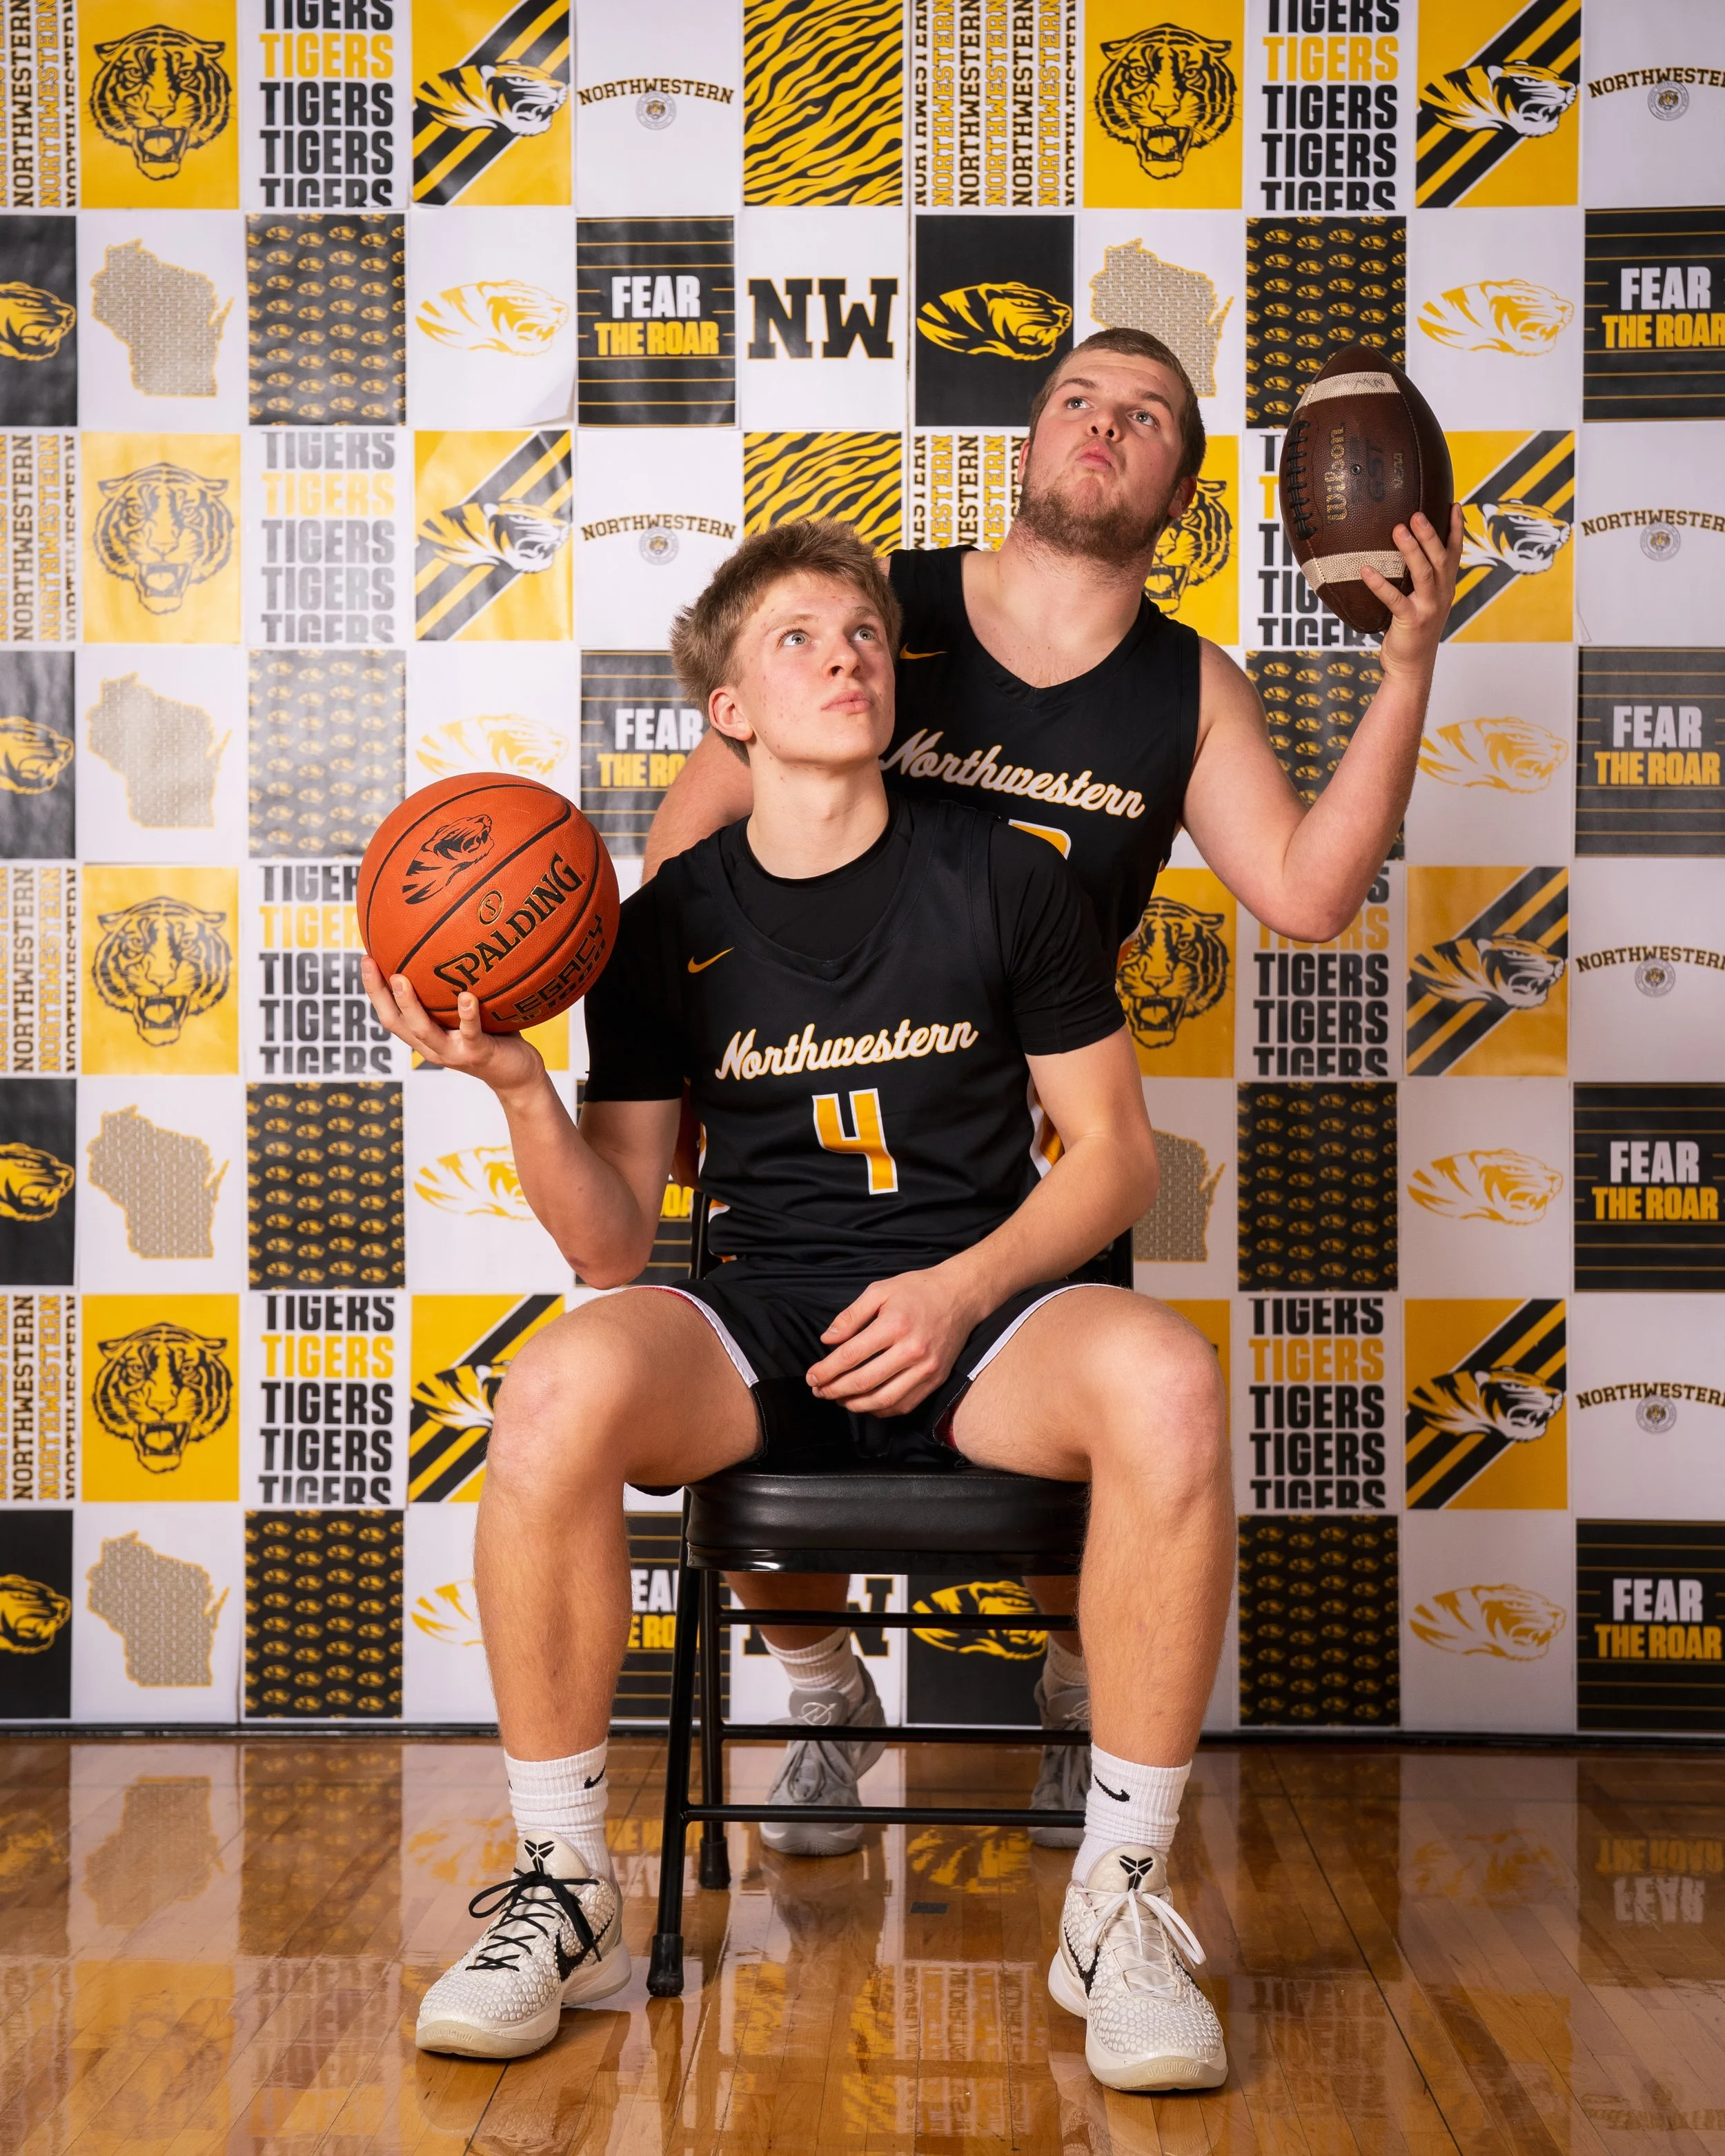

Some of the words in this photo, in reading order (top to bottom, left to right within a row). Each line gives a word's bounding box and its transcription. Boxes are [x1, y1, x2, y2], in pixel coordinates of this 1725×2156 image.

[265, 0, 393, 30] TIGERS
[1268, 0, 1399, 32] TIGERS
[259, 32, 393, 79] TIGERS
[1263, 36, 1399, 81] TIGERS
[10, 0, 33, 207] NORTHWESTERN
[37, 0, 61, 207] NORTHWESTERN
[259, 81, 393, 126] TIGERS
[577, 77, 735, 106] NORTHWESTERN
[932, 0, 954, 206] NORTHWESTERN
[959, 0, 980, 206] NORTHWESTERN
[985, 0, 1007, 206] NORTHWESTERN
[1012, 0, 1034, 206] NORTHWESTERN
[1038, 0, 1061, 206] NORTHWESTERN
[1587, 66, 1725, 99] NORTHWESTE
[1262, 85, 1397, 130] TIGERS
[259, 130, 393, 175] TIGERS
[1261, 132, 1397, 177] TIGERS
[259, 178, 393, 208] TIGERS
[1261, 181, 1396, 210] TIGERS
[611, 275, 700, 318] FEAR
[1621, 266, 1711, 310] FEAR
[594, 322, 644, 356] THE
[647, 321, 719, 355] ROAR
[747, 277, 899, 360] NW
[1601, 314, 1652, 348] THE
[1656, 313, 1725, 348] ROAR
[261, 432, 395, 469] TIGERS
[261, 473, 395, 517] TIGERS
[1324, 426, 1348, 522] Wilson
[12, 435, 33, 642] NORTHWESTERN
[38, 435, 60, 642] NORTHWESTERN
[261, 520, 395, 564] TIGERS
[580, 513, 737, 541] NORTHWESTERN
[1580, 508, 1725, 537] NORTHWESTER
[261, 566, 395, 611] TIGERS
[261, 613, 395, 644] TIGERS
[615, 708, 704, 751] FEAR
[1613, 705, 1702, 748] FEAR
[597, 753, 647, 787] THE
[649, 753, 687, 787] RO
[879, 728, 1145, 819] Northwestern
[1594, 751, 1644, 785] THE
[1648, 751, 1721, 785] ROAR
[259, 906, 364, 949] TIGER
[433, 852, 584, 998] SPALDING
[13, 867, 34, 1073] NORTHWESTERN
[39, 867, 61, 1073] NORTHWESTERN
[259, 952, 366, 995] TIGER
[491, 913, 604, 1022] LEGACY
[1254, 953, 1388, 998] TIGERS
[1253, 1000, 1388, 1045] TIGERS
[259, 1046, 391, 1074] TIGERS
[715, 1018, 978, 1081] Northwestern
[1253, 1047, 1388, 1077] TIGERS
[811, 1087, 898, 1195] 4
[1610, 1140, 1699, 1183] FEAR
[1591, 1186, 1642, 1220] THE
[1645, 1186, 1719, 1220] ROAR
[262, 1294, 395, 1332] TIGERS
[1248, 1297, 1383, 1335] TIGERS
[260, 1334, 394, 1378] TIGERS
[1248, 1337, 1384, 1383] TIGERS
[13, 1295, 33, 1500] NORTHWESTERN
[38, 1294, 61, 1500] NORTHWESTERN
[260, 1381, 393, 1425] TIGERS
[1249, 1385, 1385, 1430] TIGERS
[259, 1428, 392, 1472] TIGERS
[1250, 1432, 1386, 1477] TIGERS
[258, 1475, 391, 1505] TIGERS
[1250, 1480, 1386, 1510] TIGERS
[1613, 1578, 1703, 1622] FEAR
[1594, 1623, 1646, 1659] THE
[1648, 1624, 1722, 1660] ROAR
